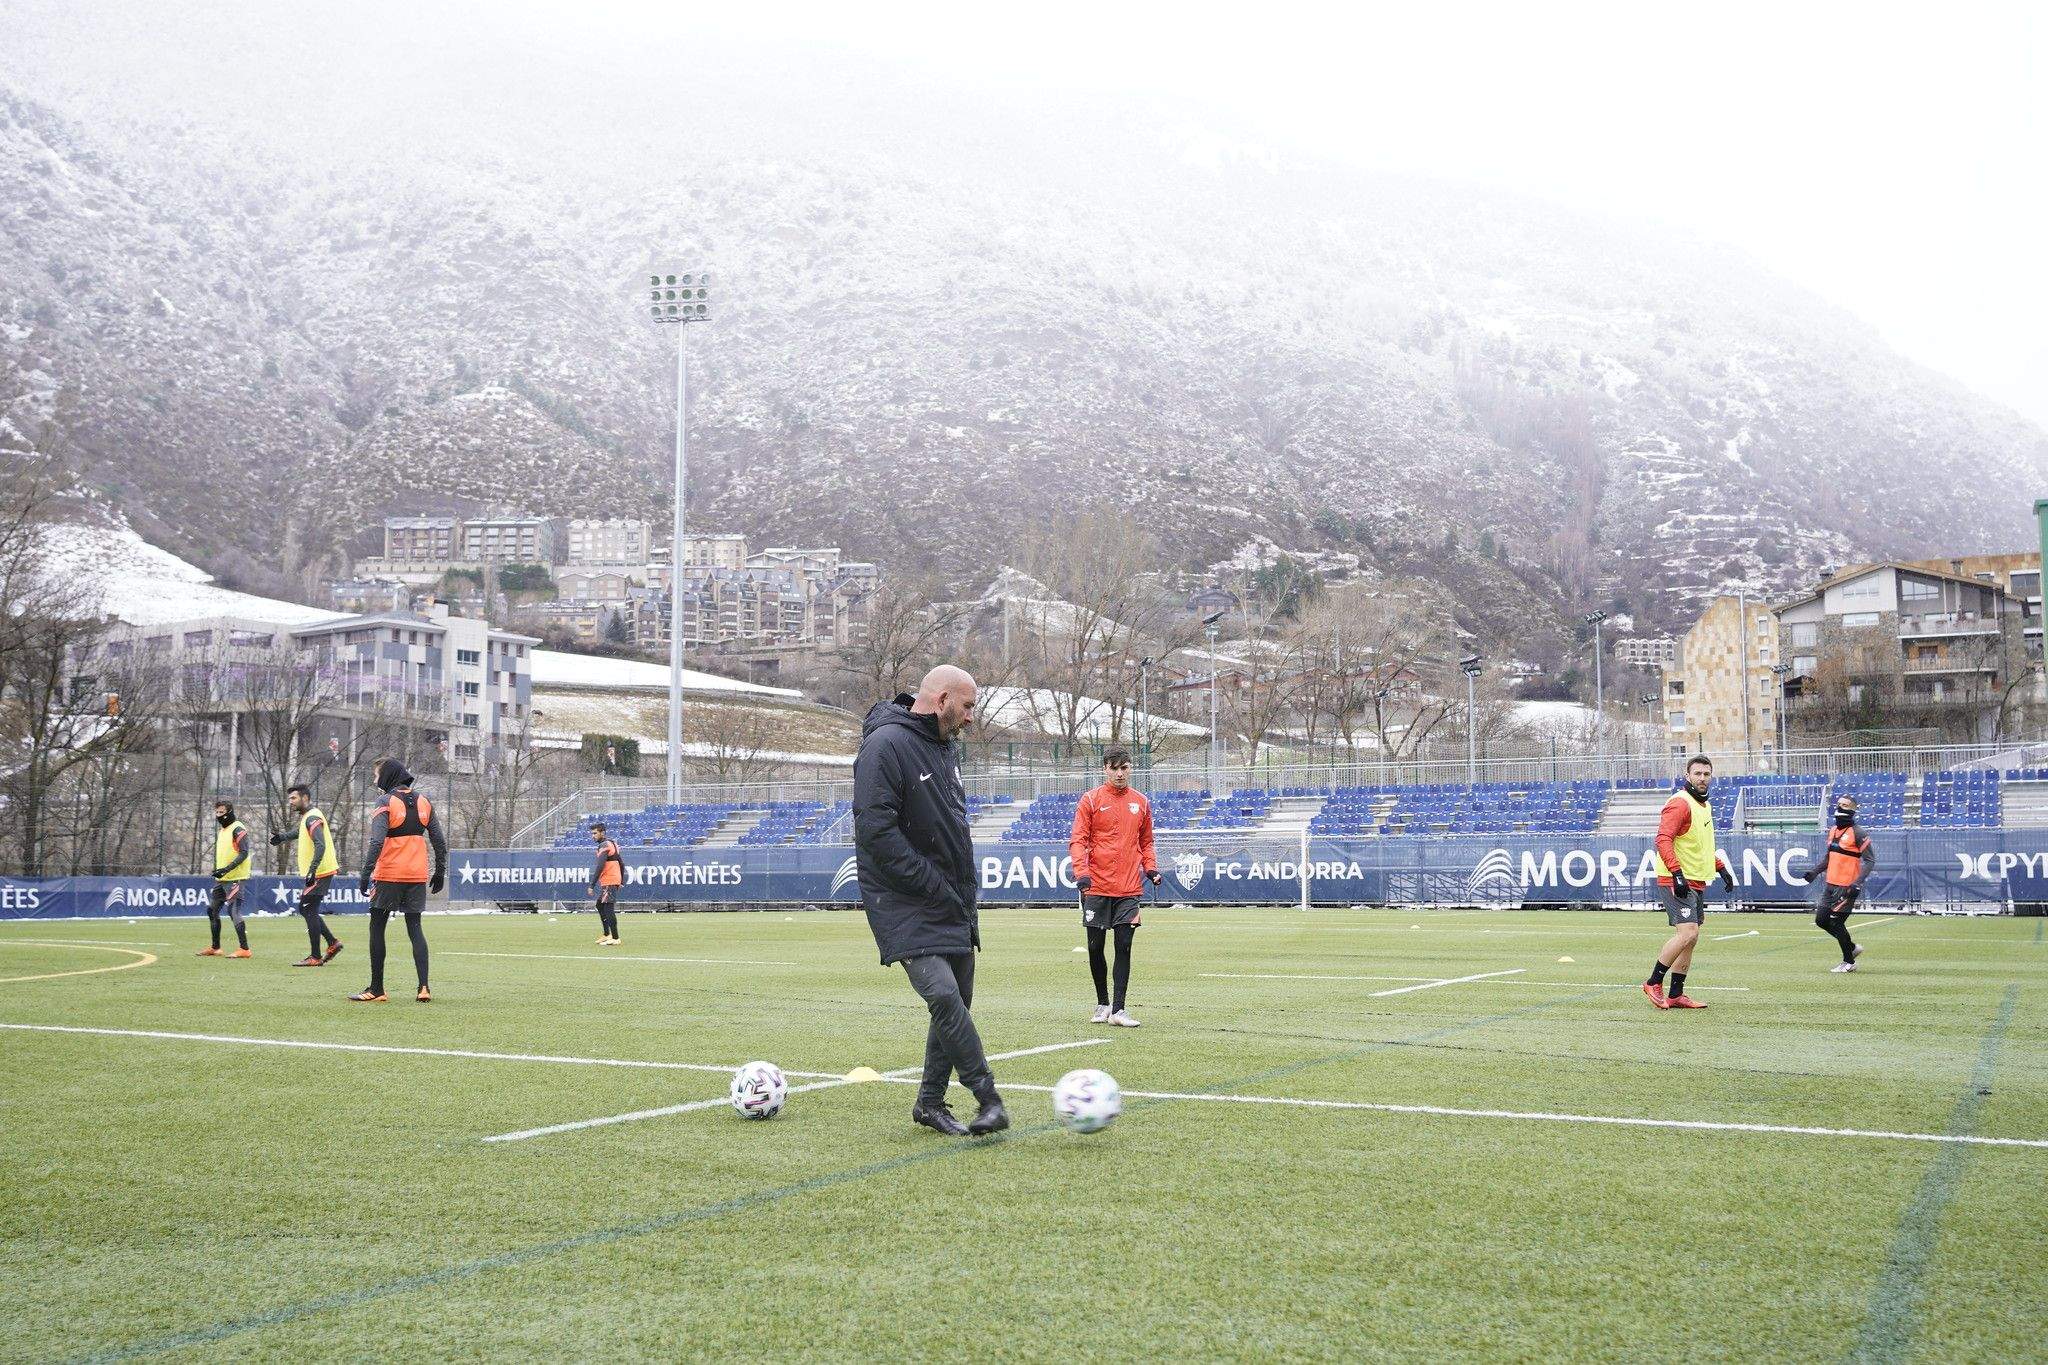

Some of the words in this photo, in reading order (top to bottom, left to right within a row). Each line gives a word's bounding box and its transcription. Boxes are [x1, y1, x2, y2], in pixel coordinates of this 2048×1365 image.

[478, 867, 543, 884] ESTRELLA
[545, 867, 590, 884] DAMM
[1214, 862, 1242, 880] FC
[1247, 861, 1364, 880] ANDORRA
